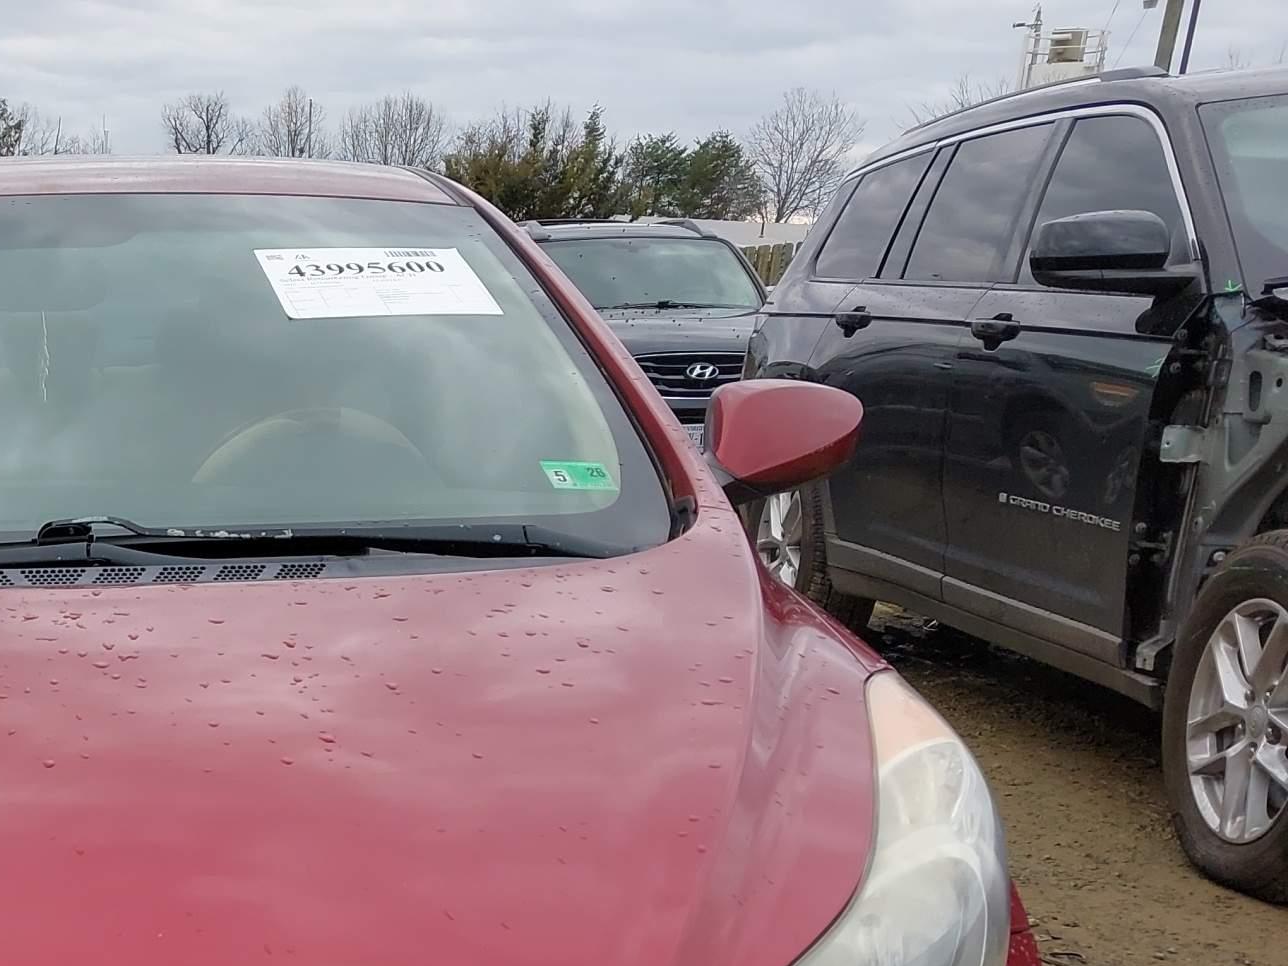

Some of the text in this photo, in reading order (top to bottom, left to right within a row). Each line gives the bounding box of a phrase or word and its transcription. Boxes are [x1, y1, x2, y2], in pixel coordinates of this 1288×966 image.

[287, 260, 445, 278] 43995600
[553, 470, 567, 483] 5
[1009, 495, 1121, 532] GRAND CHEROKEE
